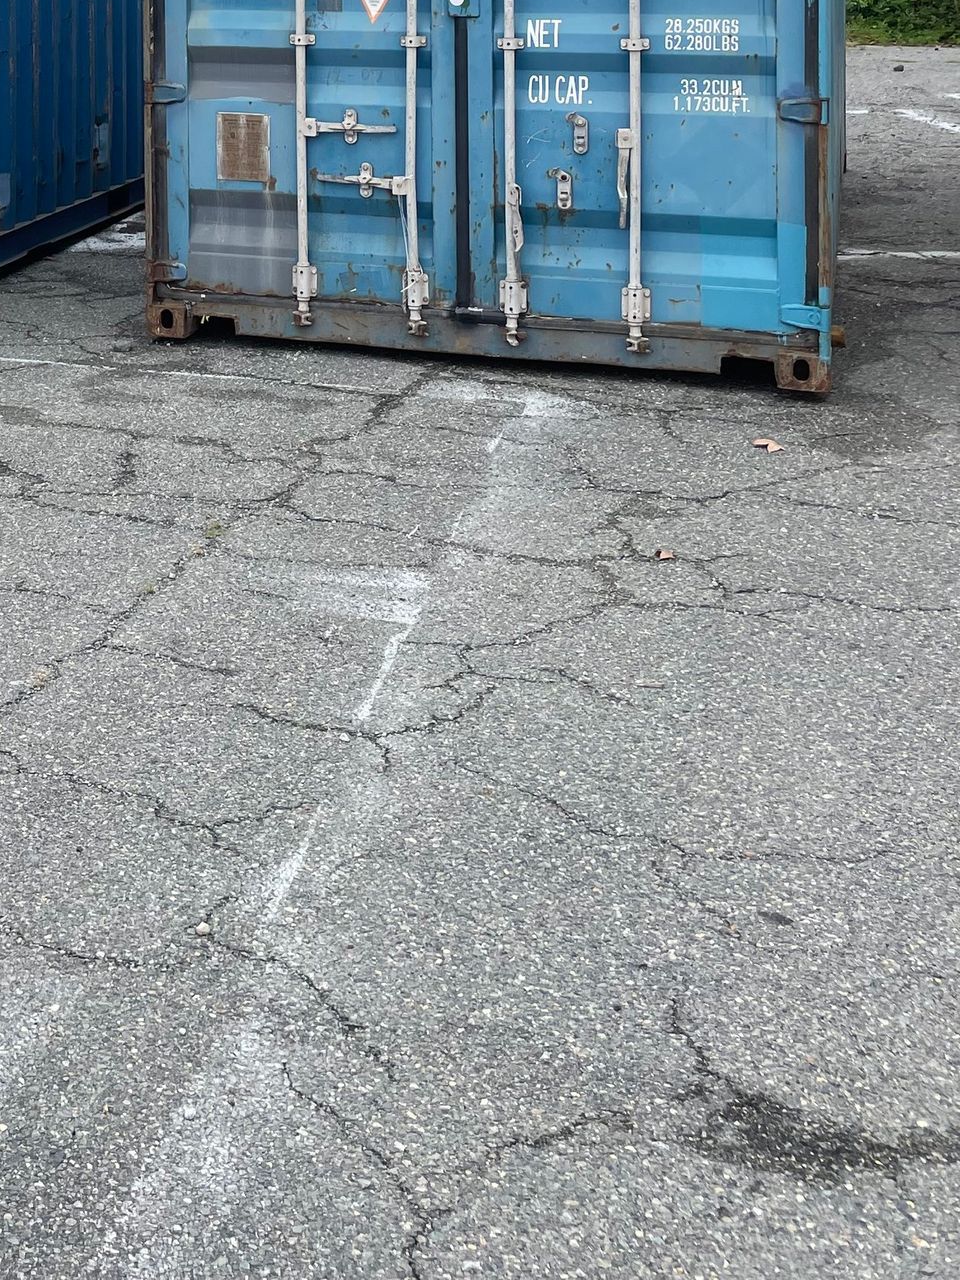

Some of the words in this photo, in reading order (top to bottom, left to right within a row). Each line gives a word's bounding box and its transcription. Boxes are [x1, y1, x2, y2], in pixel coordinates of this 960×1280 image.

[526, 19, 562, 48] NET
[528, 75, 549, 104] CU
[555, 75, 592, 105] CAP.
